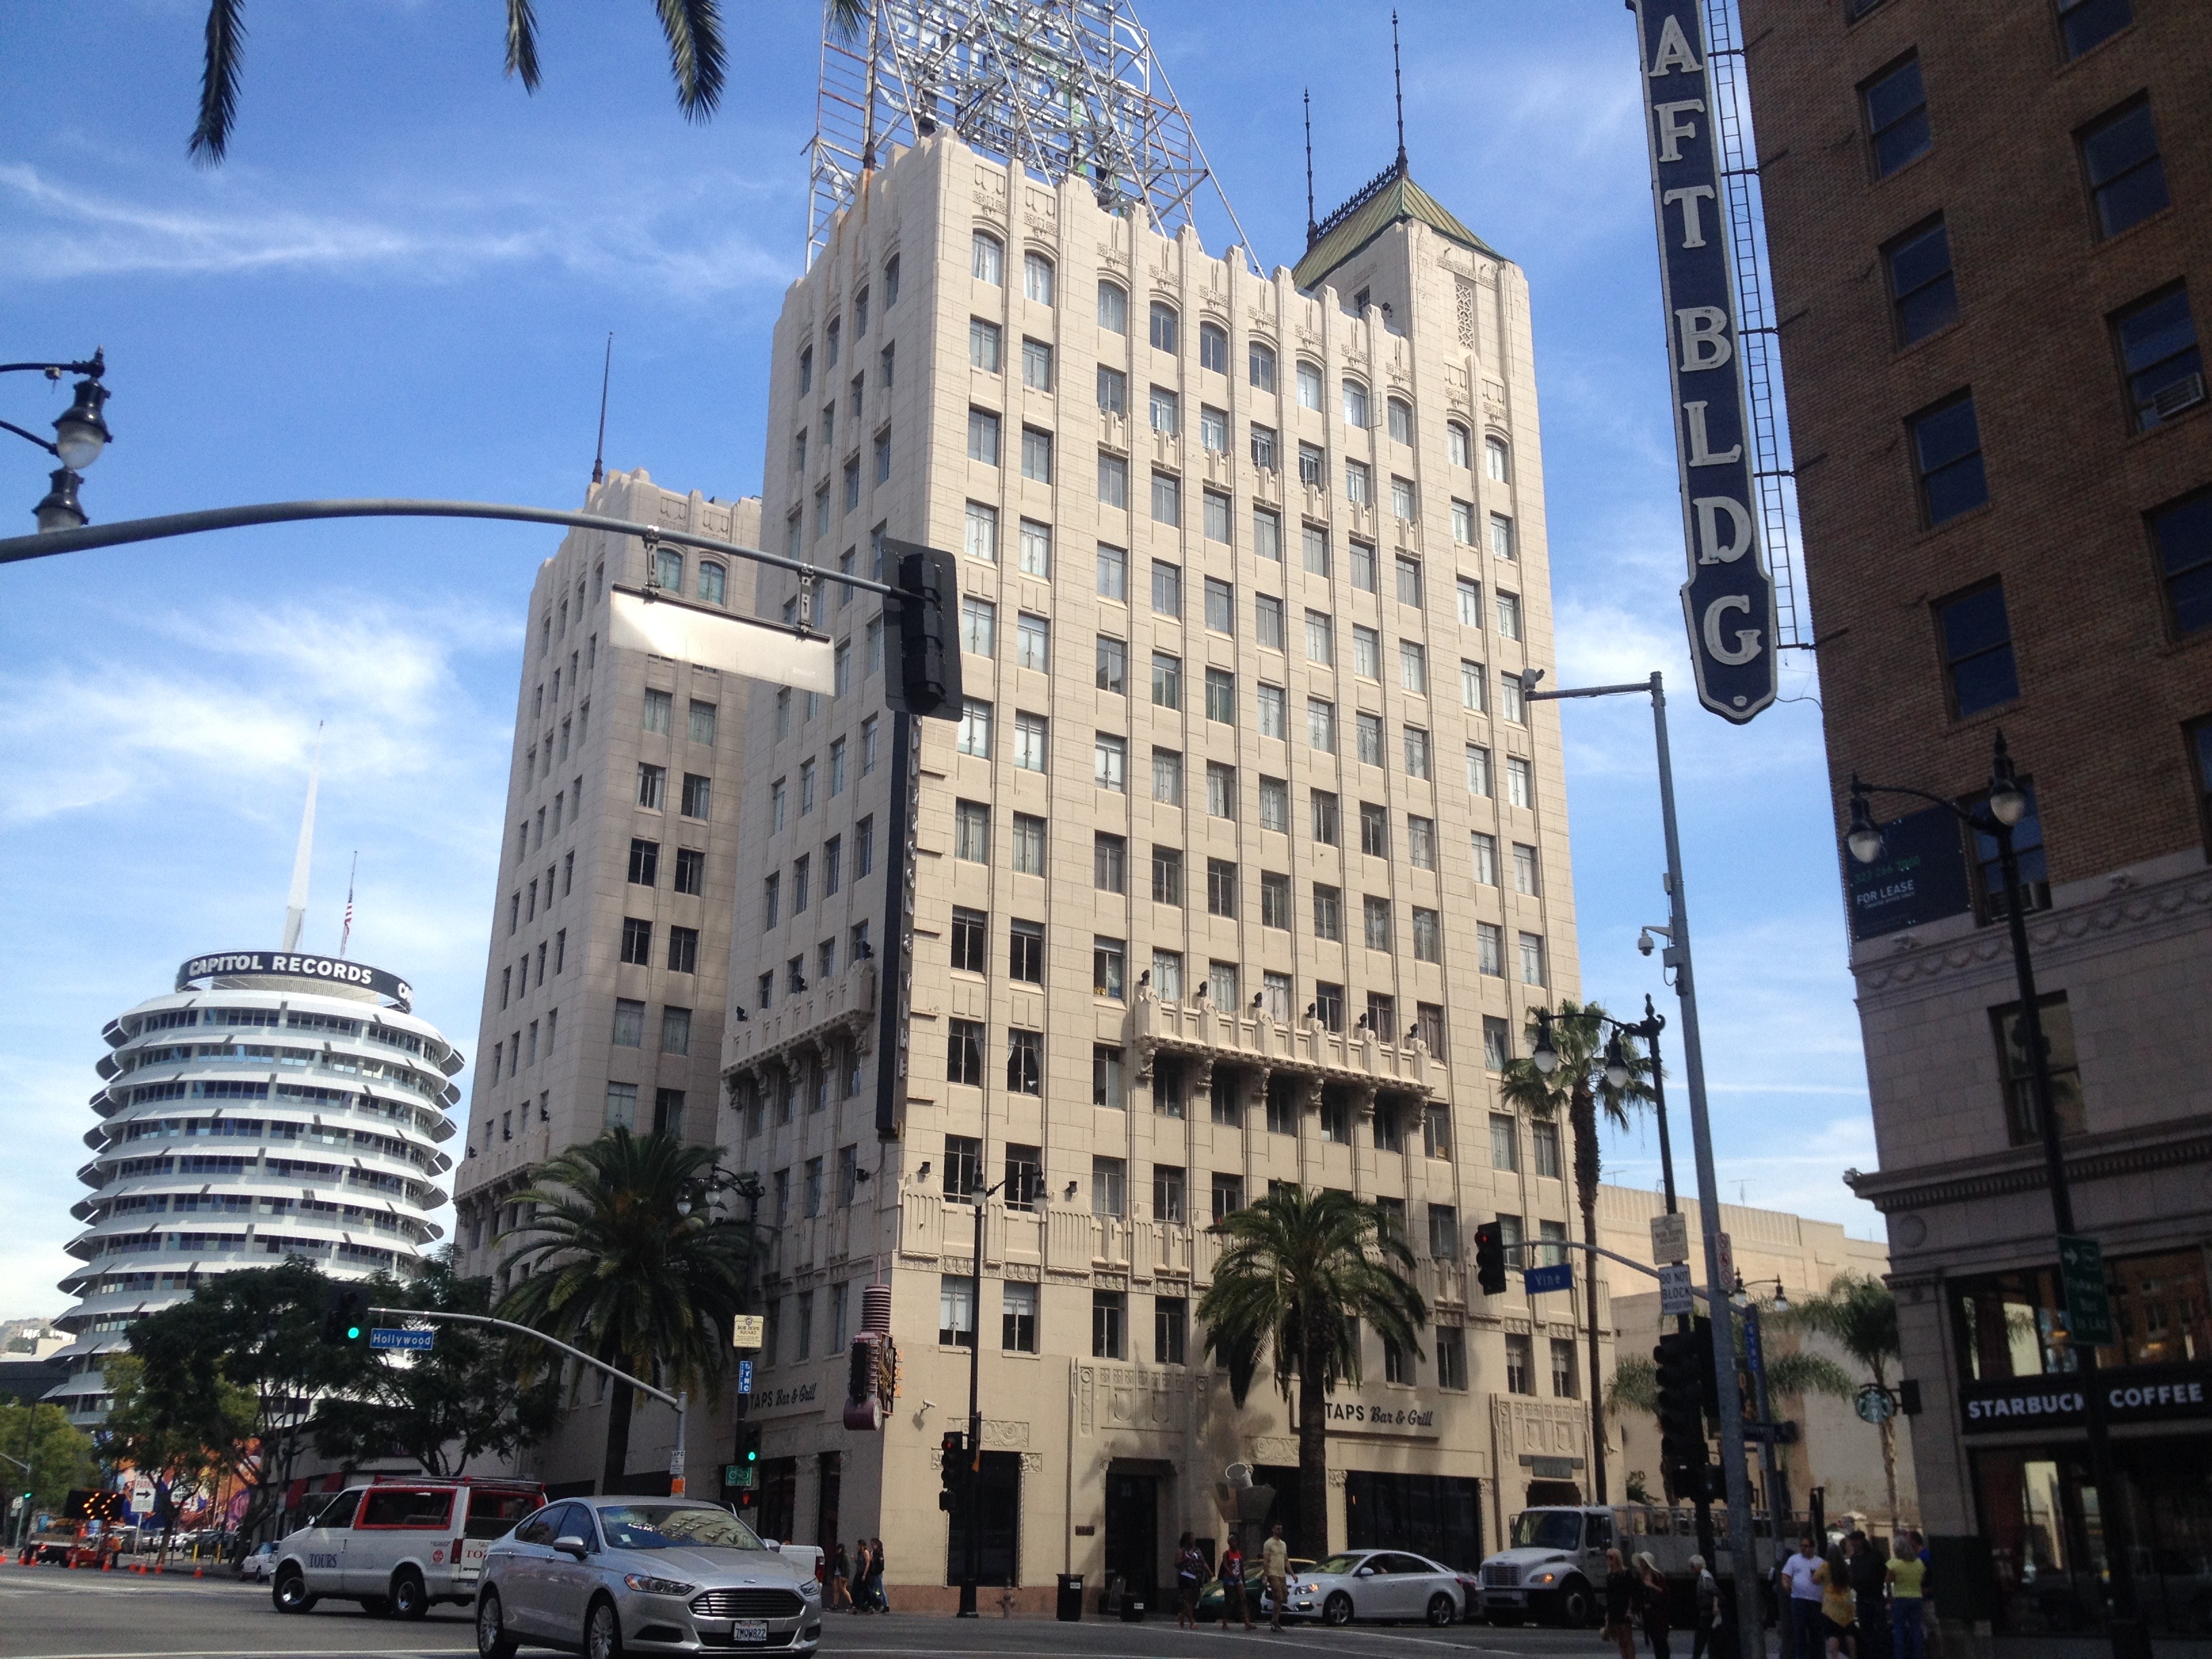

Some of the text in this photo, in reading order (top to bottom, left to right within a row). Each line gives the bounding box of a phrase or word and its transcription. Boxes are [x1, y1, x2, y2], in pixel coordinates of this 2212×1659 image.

[1648, 14, 1763, 666] AFT BLDG
[905, 715, 923, 916] OLLYWOOD
[1857, 890, 1877, 905] FOR
[1880, 880, 1914, 899] LEASE
[188, 955, 372, 985] CAPITOL RECORDS
[1534, 1274, 1561, 1286] Vine
[1674, 1271, 1689, 1283] NOT
[1662, 1286, 1692, 1300] BLOCK
[373, 1333, 431, 1347] Hollywood
[750, 1382, 817, 1410] TAPS Bar & Grill
[1967, 1383, 2203, 1418] STARBUCK COFFEE
[1325, 1402, 1434, 1427] TAPS Bar & Grill
[309, 1553, 337, 1568] TOURS
